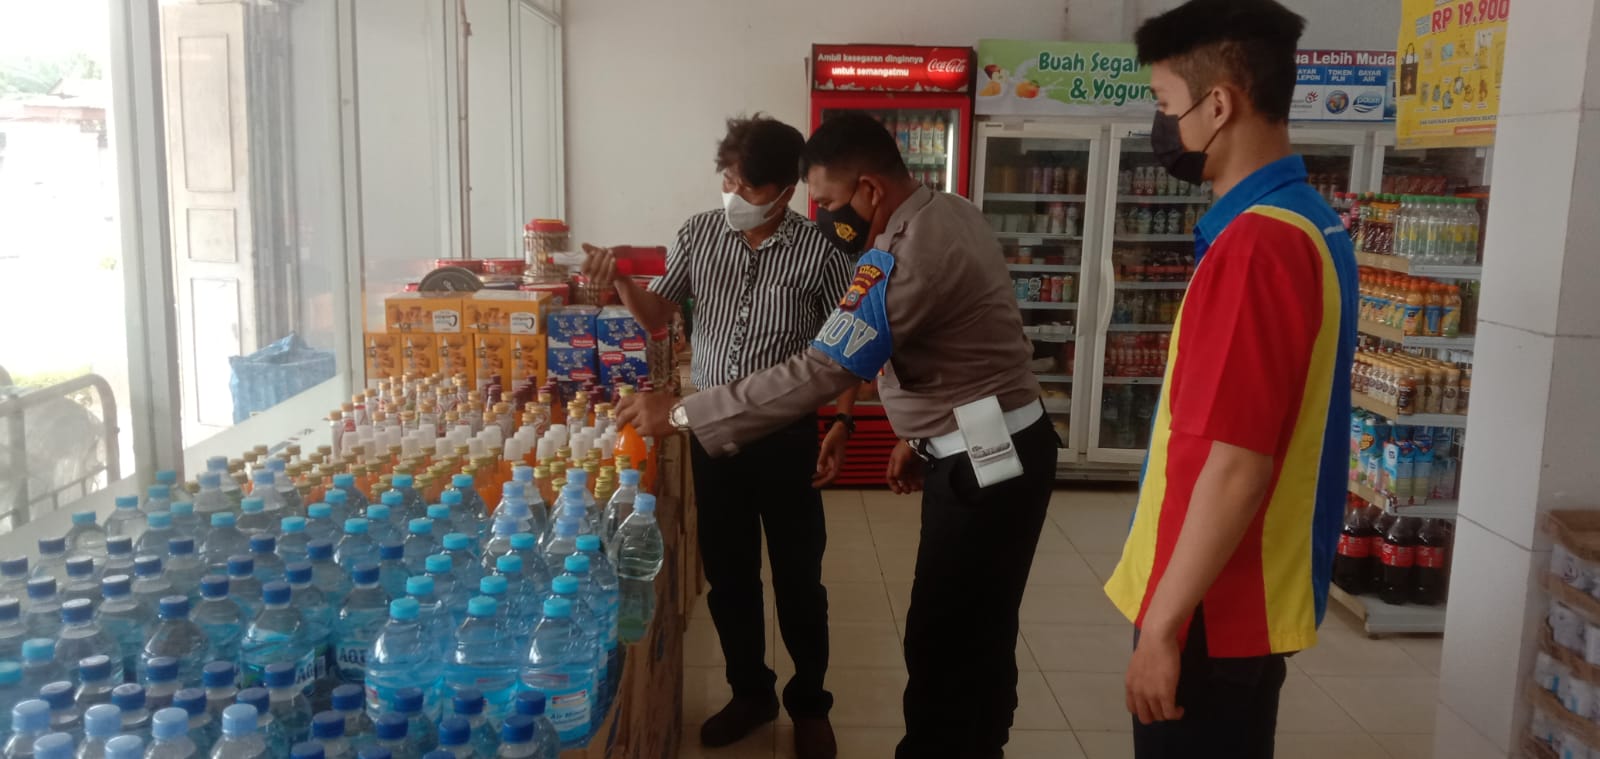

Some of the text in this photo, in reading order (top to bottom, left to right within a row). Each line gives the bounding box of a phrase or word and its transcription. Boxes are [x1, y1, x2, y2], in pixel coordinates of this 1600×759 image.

[1431, 7, 1453, 34] RP
[1457, 0, 1511, 26] 19.900
[817, 53, 924, 64] Ambil kesegaran dinginnya
[1039, 52, 1084, 71] Buah
[1313, 52, 1353, 65] Lebih
[1356, 53, 1396, 65] Muda
[831, 67, 910, 77] untuk semangatmu
[1070, 78, 1087, 100] &
[815, 308, 878, 358] OV
